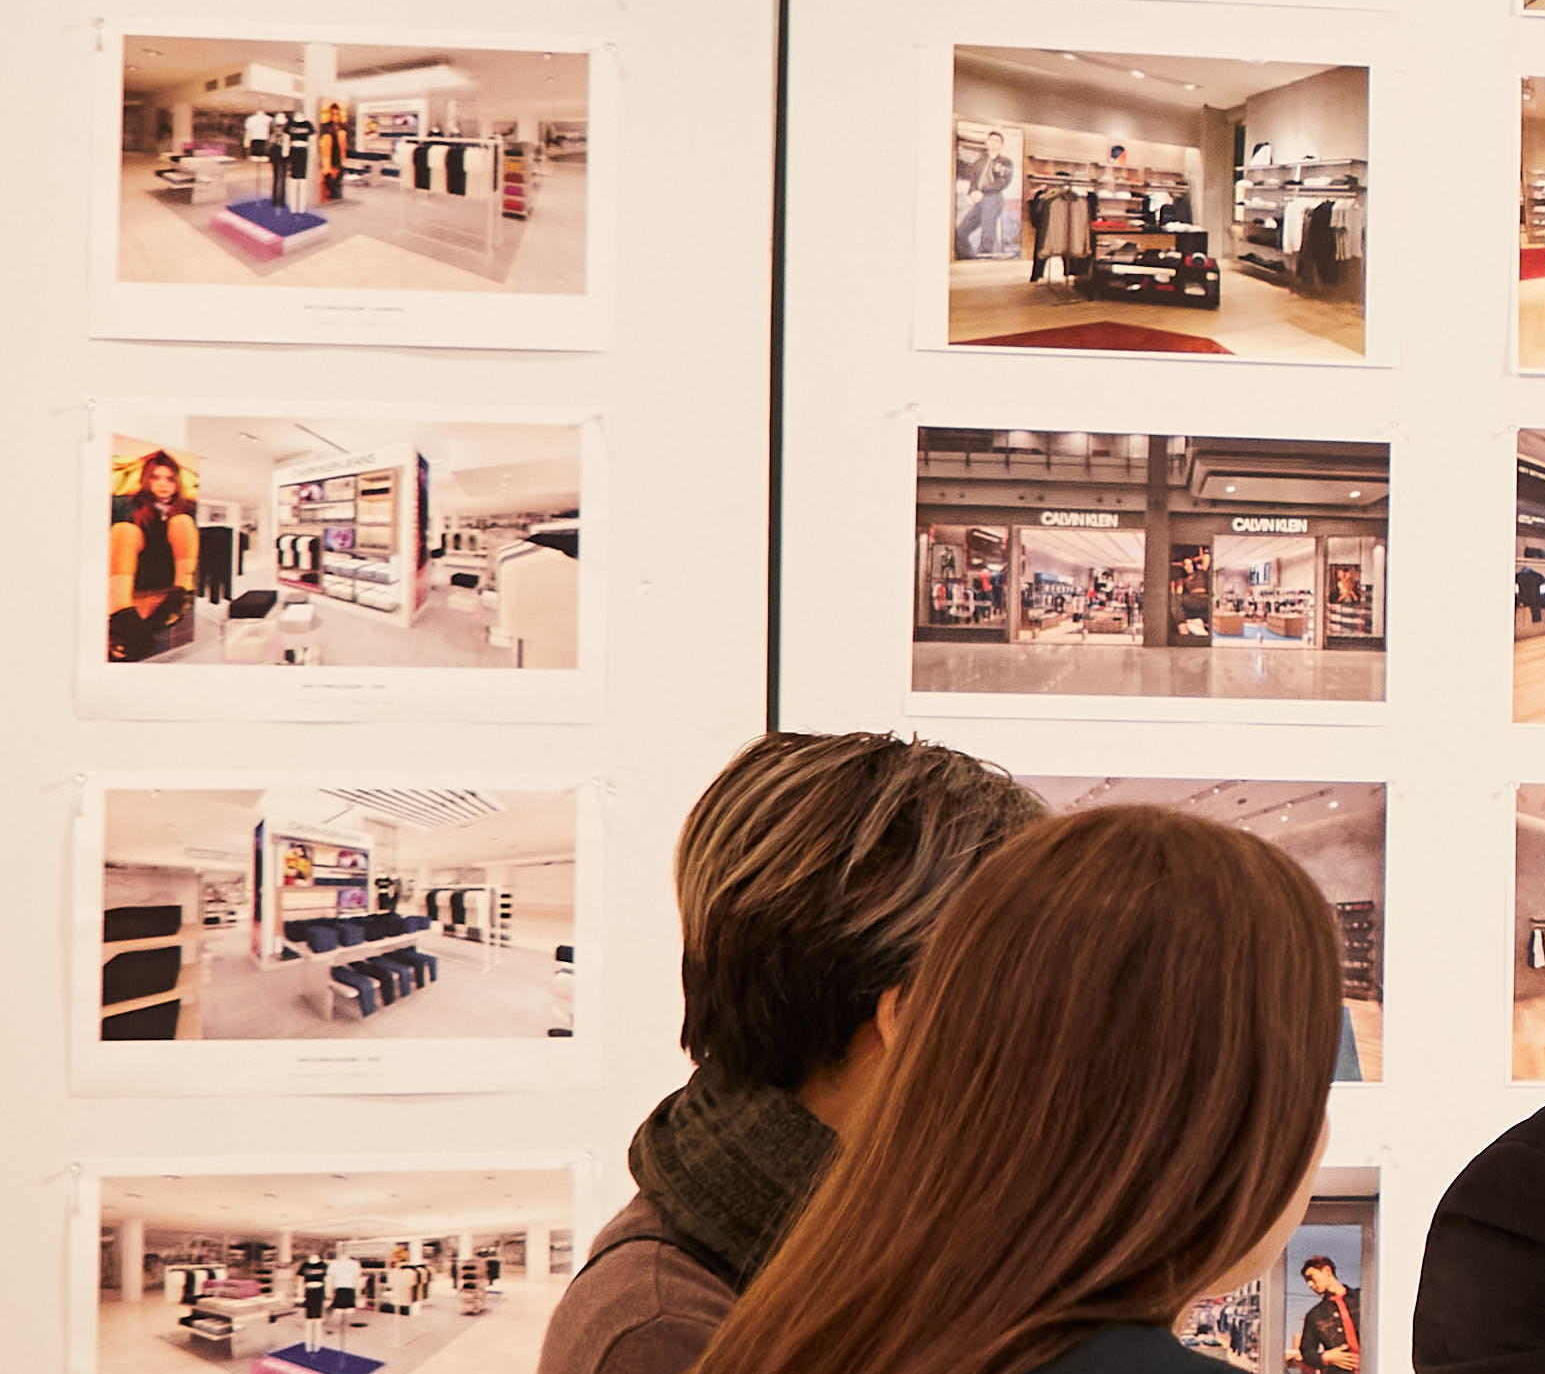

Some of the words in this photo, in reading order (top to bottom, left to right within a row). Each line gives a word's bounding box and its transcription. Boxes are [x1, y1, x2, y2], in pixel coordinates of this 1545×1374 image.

[1041, 512, 1084, 527] CALVIN
[1085, 514, 1118, 528] KLEIN
[1232, 517, 1274, 532] CALVIN
[1275, 519, 1308, 533] KLEIN
